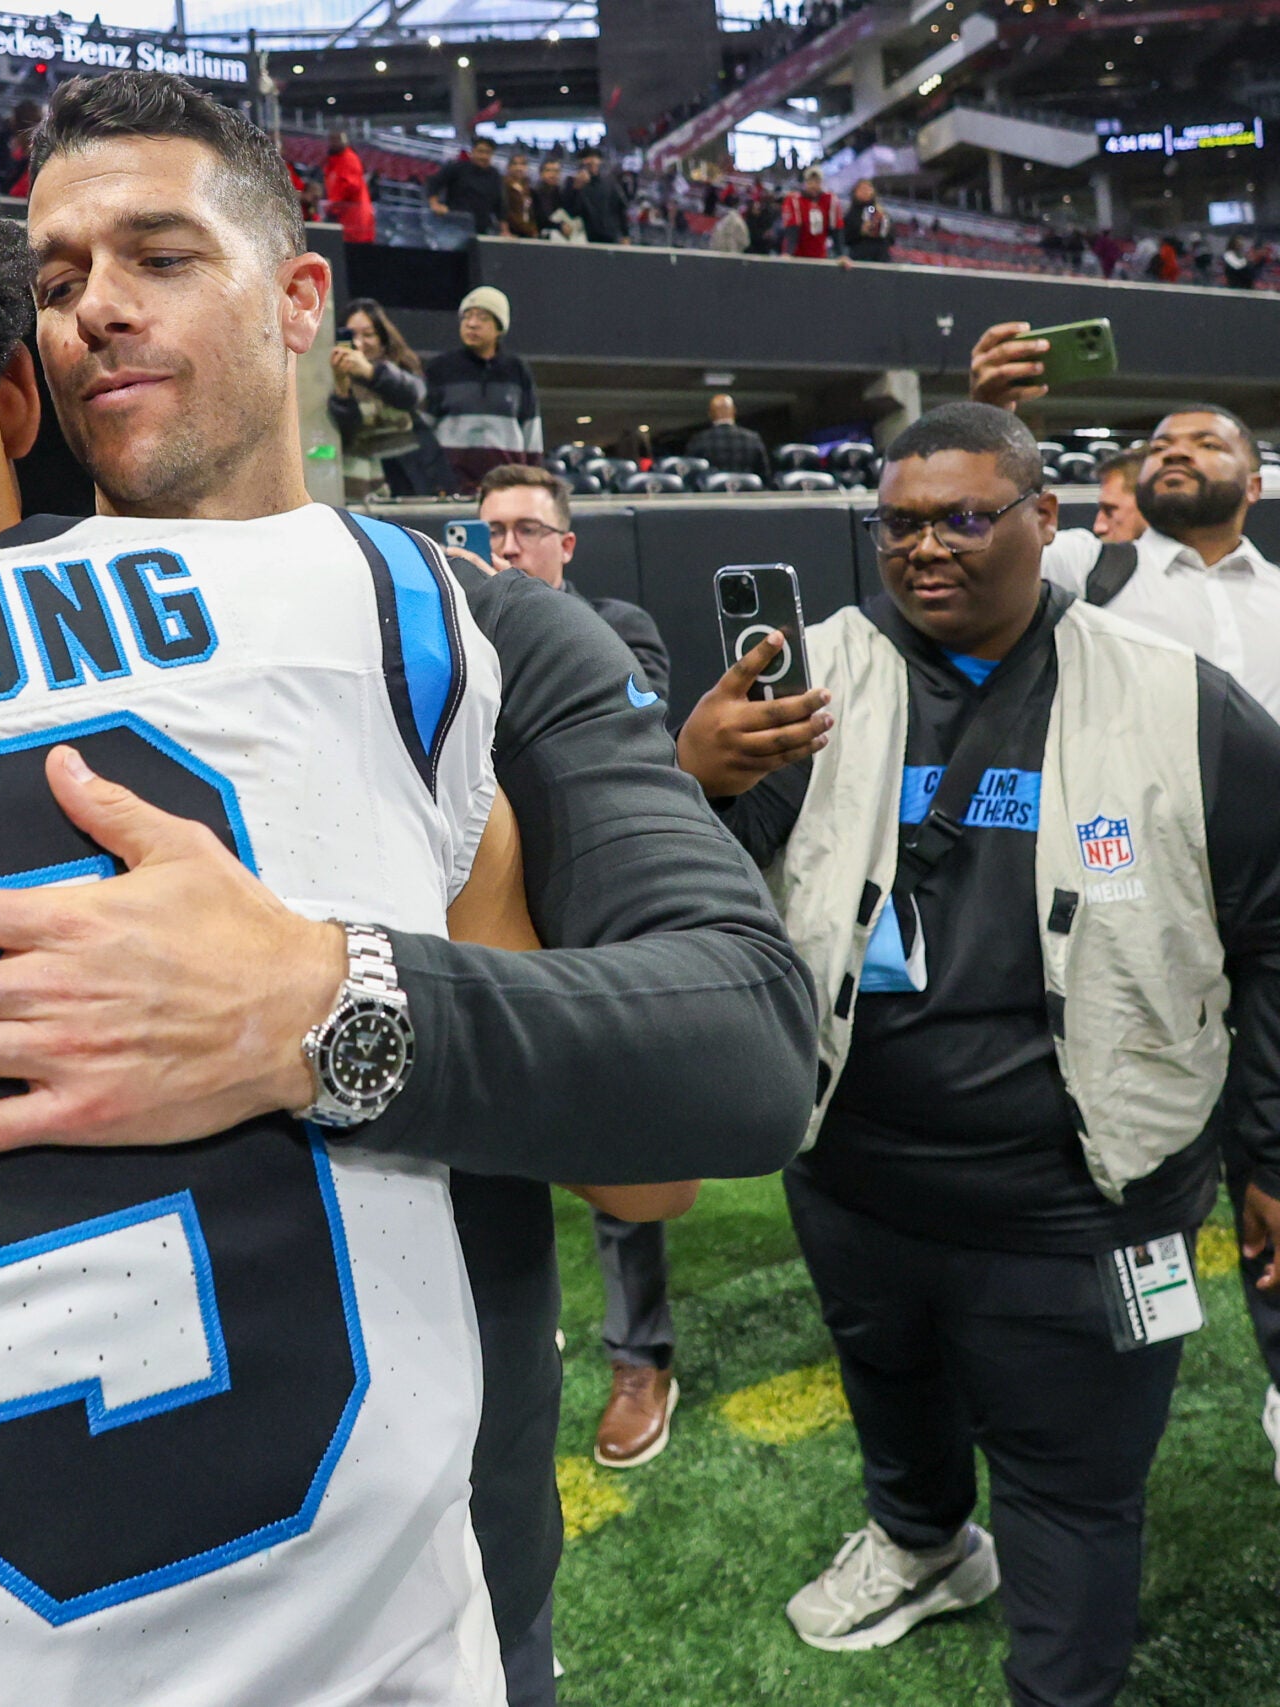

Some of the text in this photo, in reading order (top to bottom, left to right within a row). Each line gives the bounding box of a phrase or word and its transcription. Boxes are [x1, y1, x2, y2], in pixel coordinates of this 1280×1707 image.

[136, 41, 248, 84] Stadium
[923, 771, 1018, 797] CINA
[971, 799, 1032, 825] THERS
[1086, 838, 1130, 867] NFL
[1085, 879, 1148, 906] MEDIA
